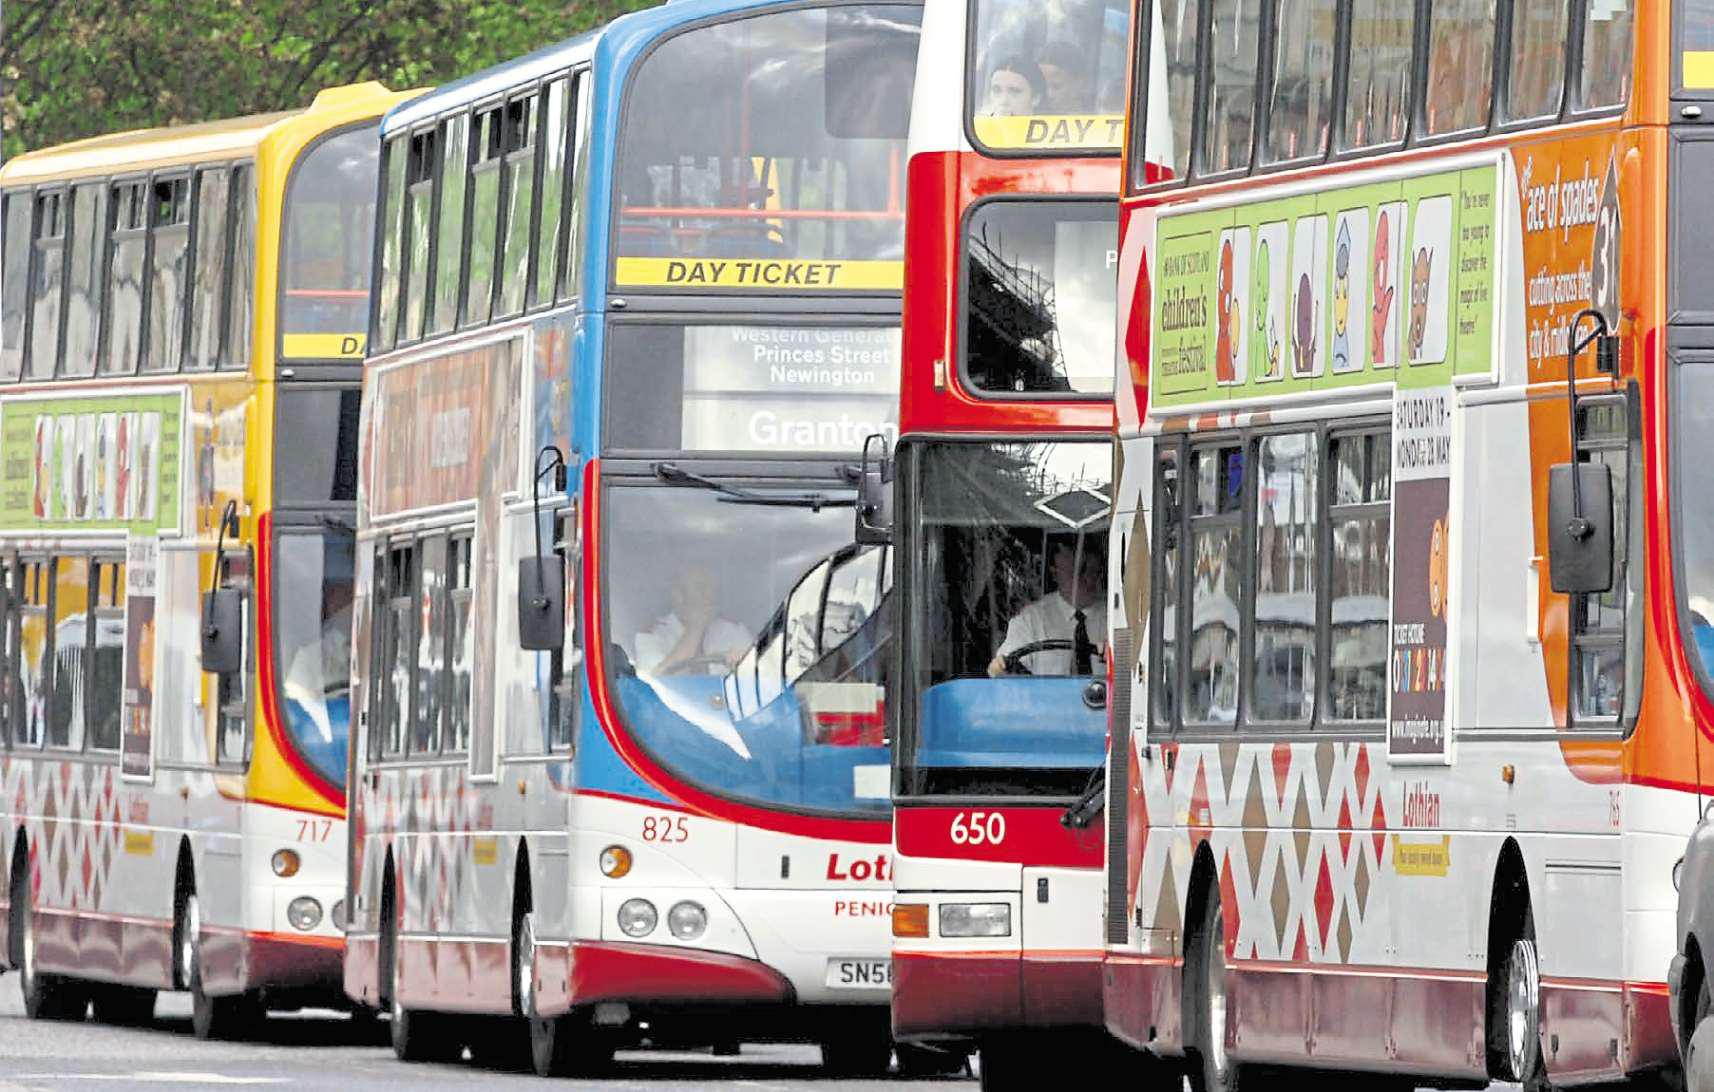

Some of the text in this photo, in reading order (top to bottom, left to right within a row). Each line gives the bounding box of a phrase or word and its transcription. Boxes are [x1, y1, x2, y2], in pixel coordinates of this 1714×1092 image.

[1025, 119, 1095, 143] DAY
[1527, 160, 1599, 243] ace of spades
[1598, 205, 1618, 307] 31
[667, 262, 842, 285] DAY TICKET
[1162, 285, 1207, 332] children's
[732, 329, 809, 343] Western
[754, 345, 890, 364] Princes Street
[1178, 336, 1207, 374] festival
[771, 365, 875, 386] Newington
[1403, 780, 1440, 828] Lothian
[296, 820, 332, 842] 717
[643, 816, 688, 842] 825
[950, 811, 1006, 846] 650
[826, 853, 894, 881] Lot
